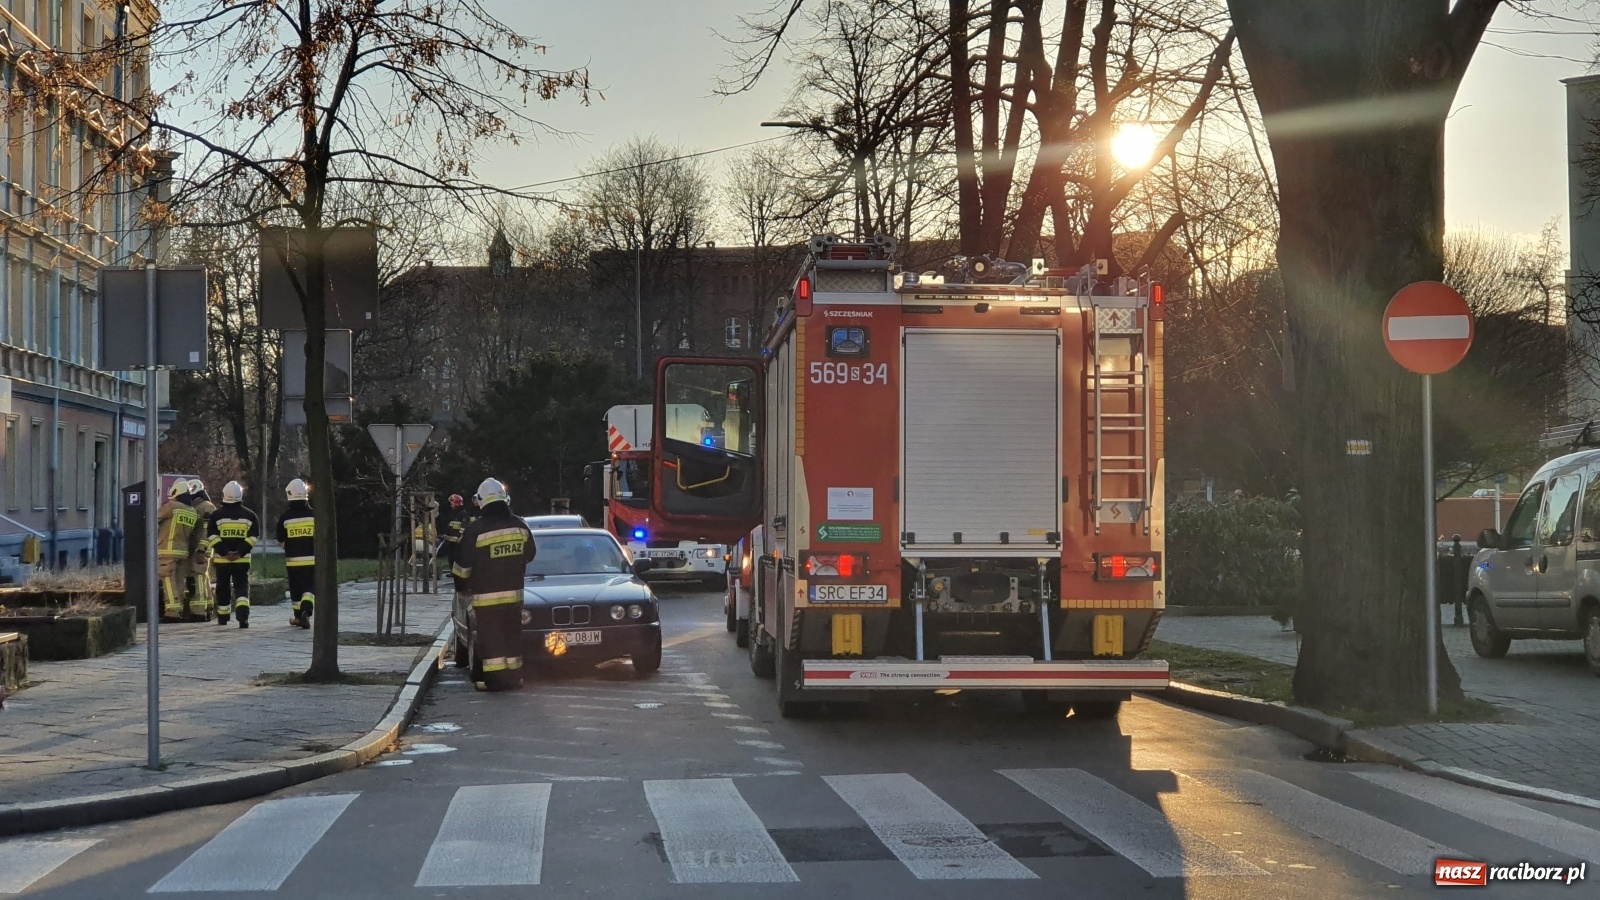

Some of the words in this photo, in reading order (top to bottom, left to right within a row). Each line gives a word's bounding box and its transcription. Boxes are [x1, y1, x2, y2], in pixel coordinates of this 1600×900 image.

[129, 493, 139, 504] P
[818, 586, 845, 600] SRC
[849, 586, 884, 600] EF34
